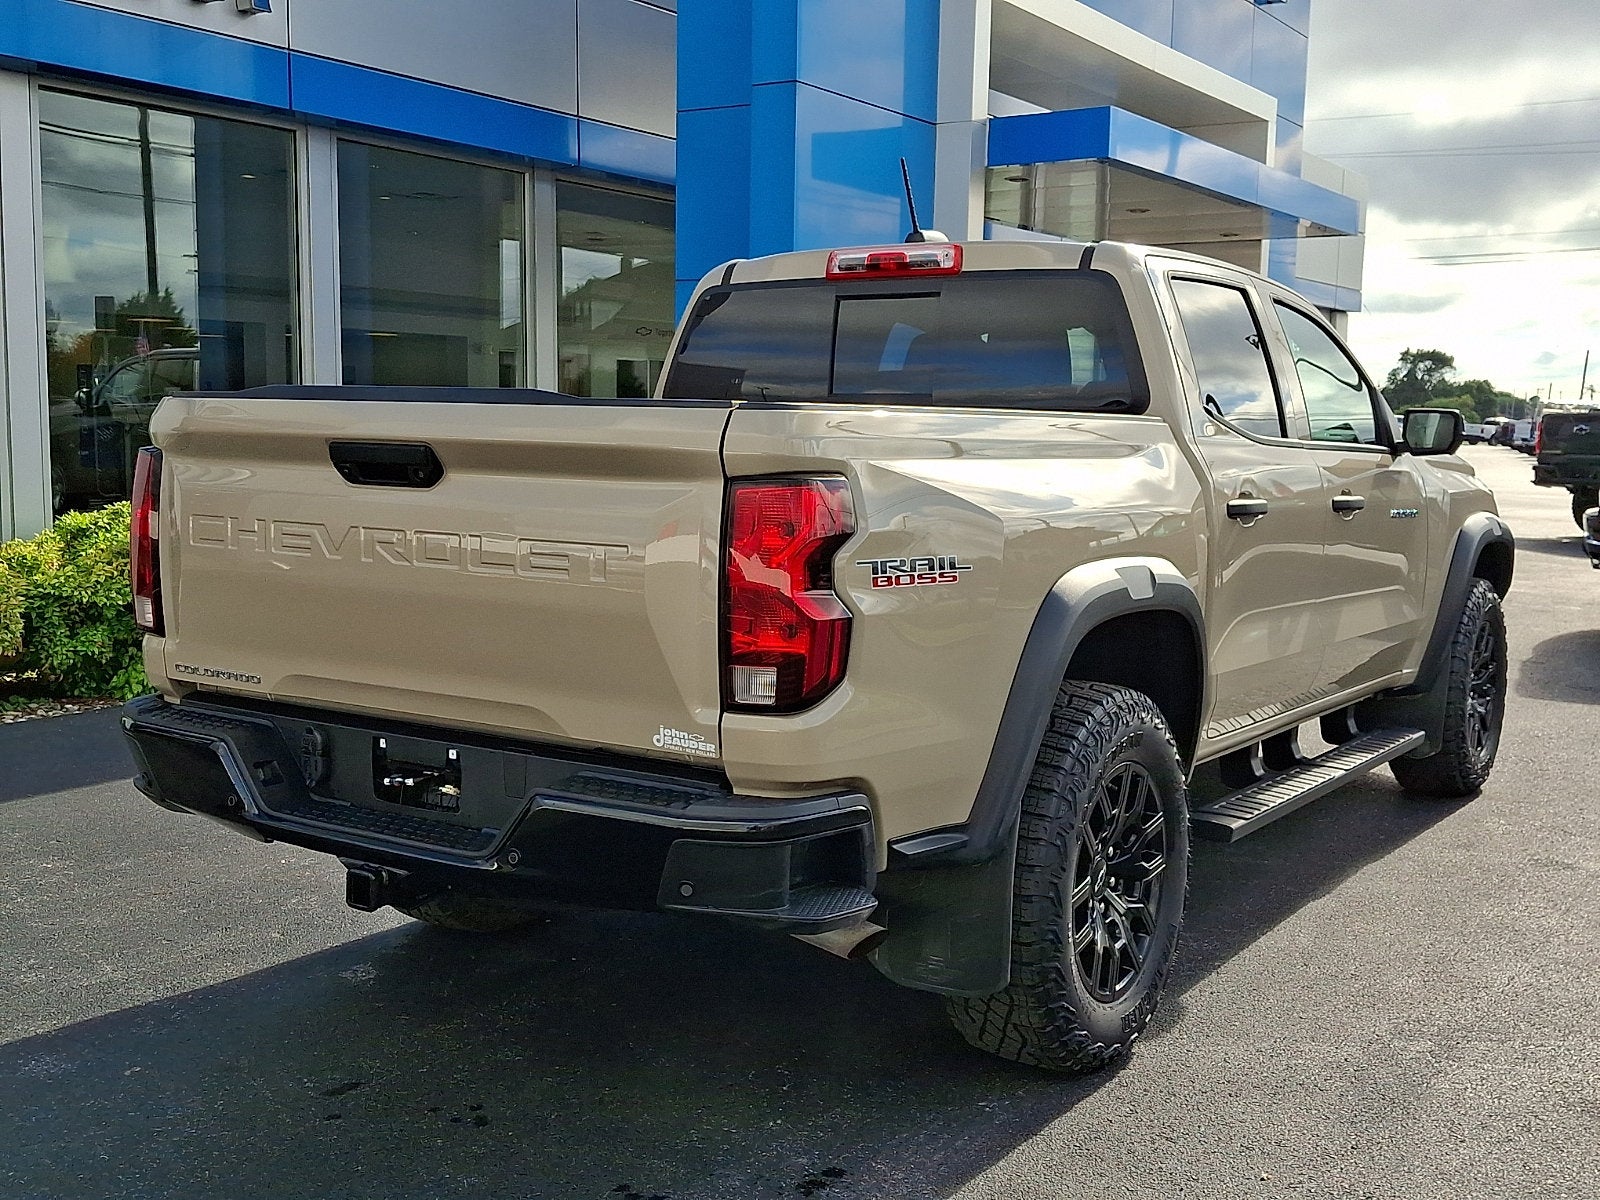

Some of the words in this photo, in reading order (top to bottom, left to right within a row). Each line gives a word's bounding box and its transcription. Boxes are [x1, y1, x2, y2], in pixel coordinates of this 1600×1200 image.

[188, 513, 632, 584] CHEVROLET
[856, 555, 973, 576] TRAIL
[871, 570, 959, 589] BOSS
[174, 662, 262, 684] COLORADO
[652, 724, 689, 747] john
[664, 736, 716, 752] SAUDER
